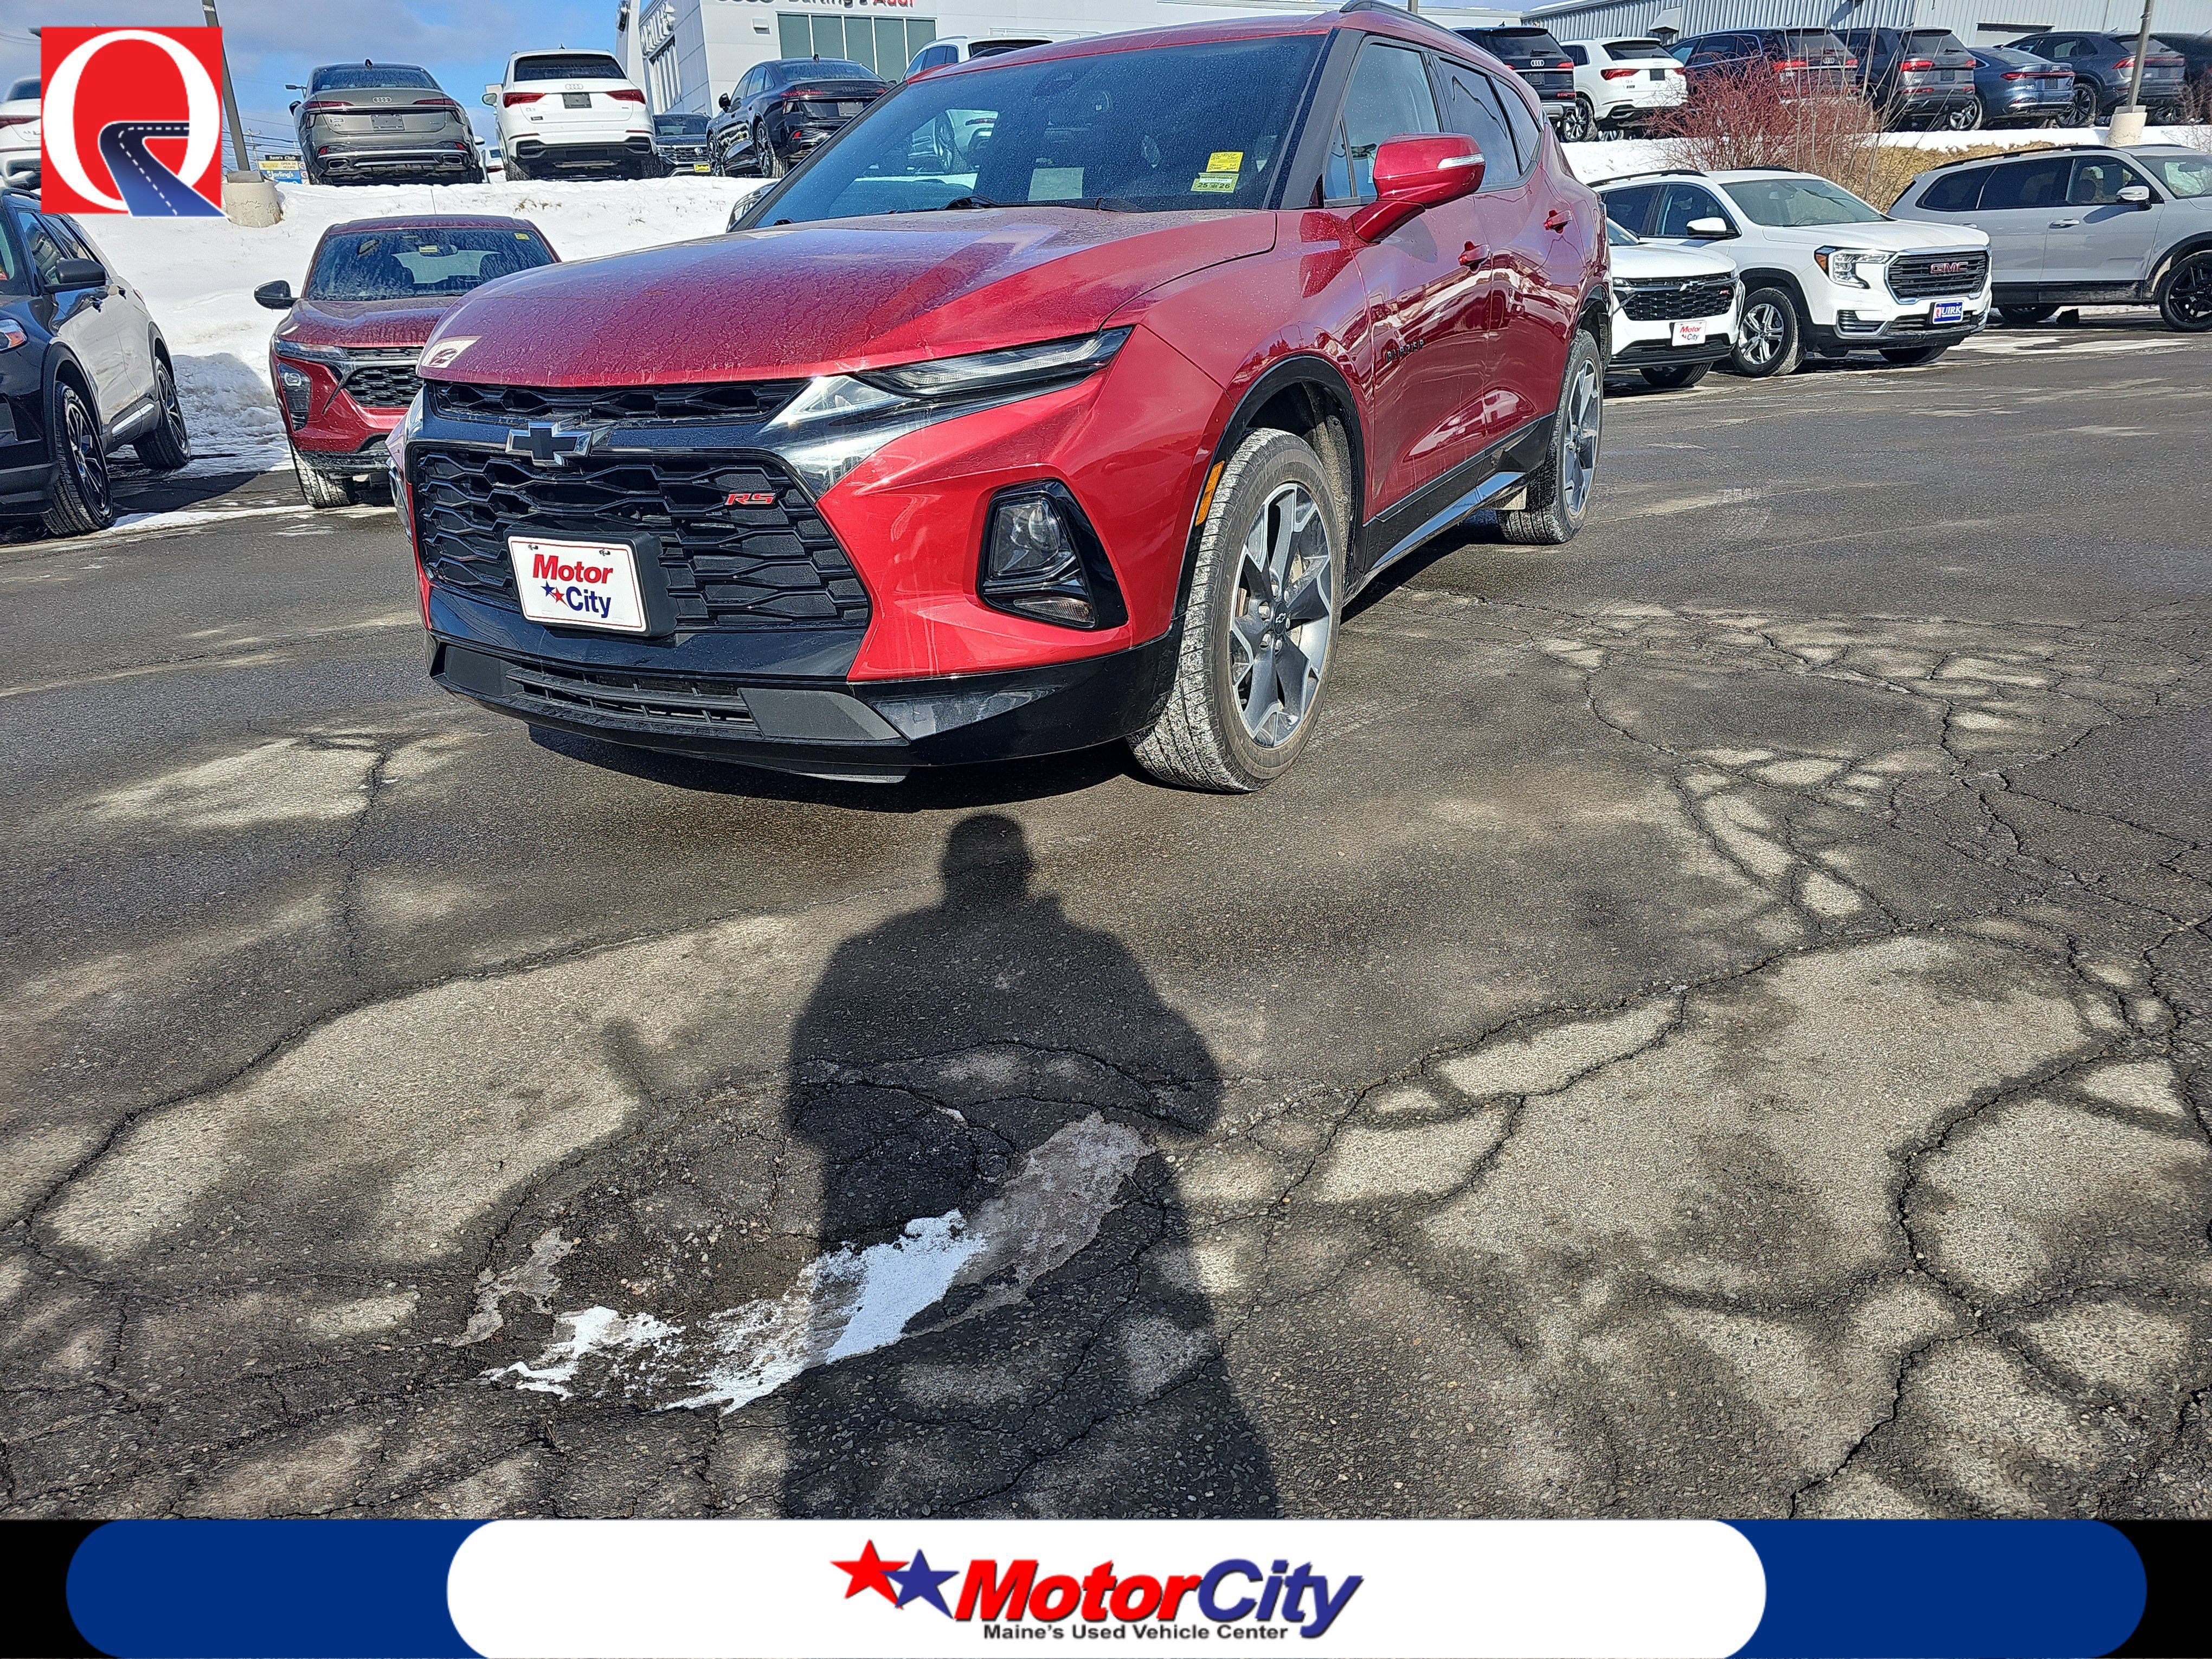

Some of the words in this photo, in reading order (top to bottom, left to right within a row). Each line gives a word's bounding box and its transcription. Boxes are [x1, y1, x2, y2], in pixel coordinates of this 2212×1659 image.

[1930, 261, 1969, 274] GMC
[724, 493, 776, 506] RS
[532, 554, 614, 584] Motor
[565, 586, 612, 619] City
